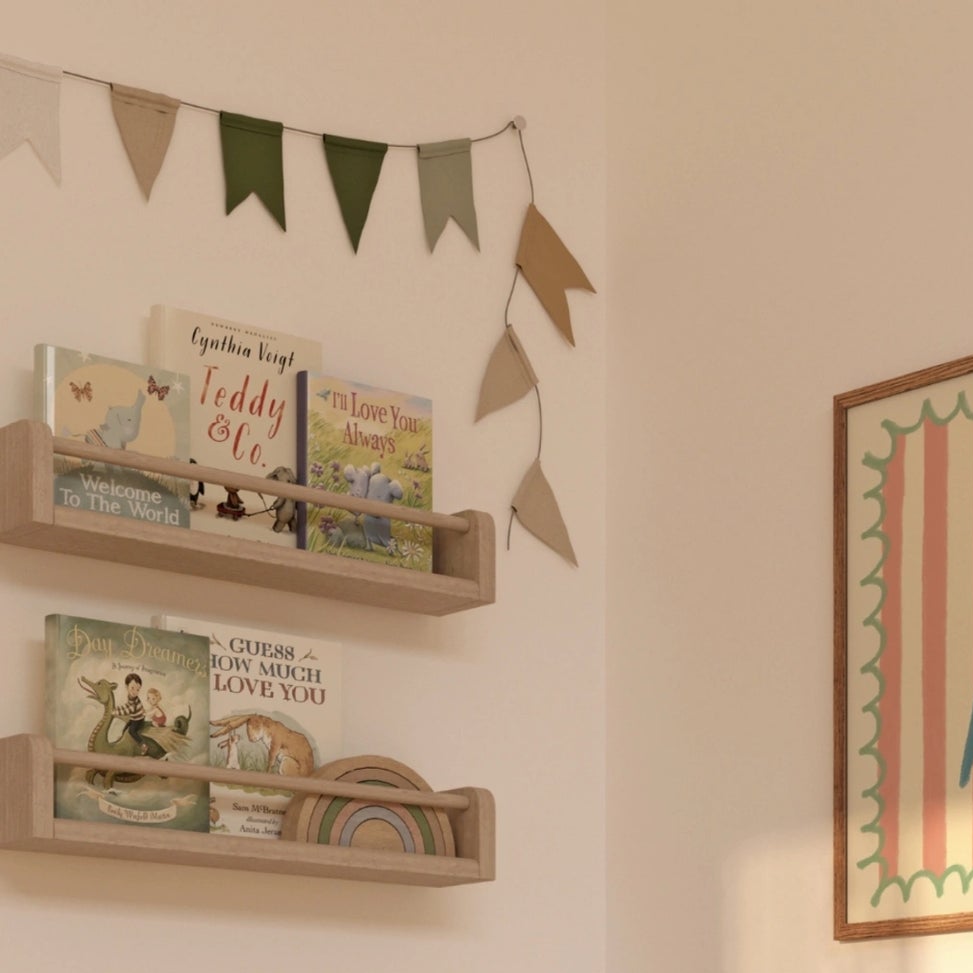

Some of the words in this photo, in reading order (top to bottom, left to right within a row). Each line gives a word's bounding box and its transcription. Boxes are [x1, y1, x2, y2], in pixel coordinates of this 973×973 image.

[191, 326, 252, 357] Cynthia
[258, 340, 295, 375] Voigt
[200, 364, 286, 440] Teddy
[350, 391, 388, 424] Love
[390, 405, 418, 434] You
[342, 420, 397, 459] Always
[59, 487, 81, 508] To
[86, 492, 121, 515] The
[128, 500, 180, 526] World
[80, 473, 162, 504] Welcome
[66, 624, 112, 660] Day
[121, 625, 209, 677] Dreamers
[228, 637, 296, 661] GUESS
[213, 673, 275, 699] LOVE
[278, 682, 327, 706] YOU
[259, 660, 322, 685] MUCH
